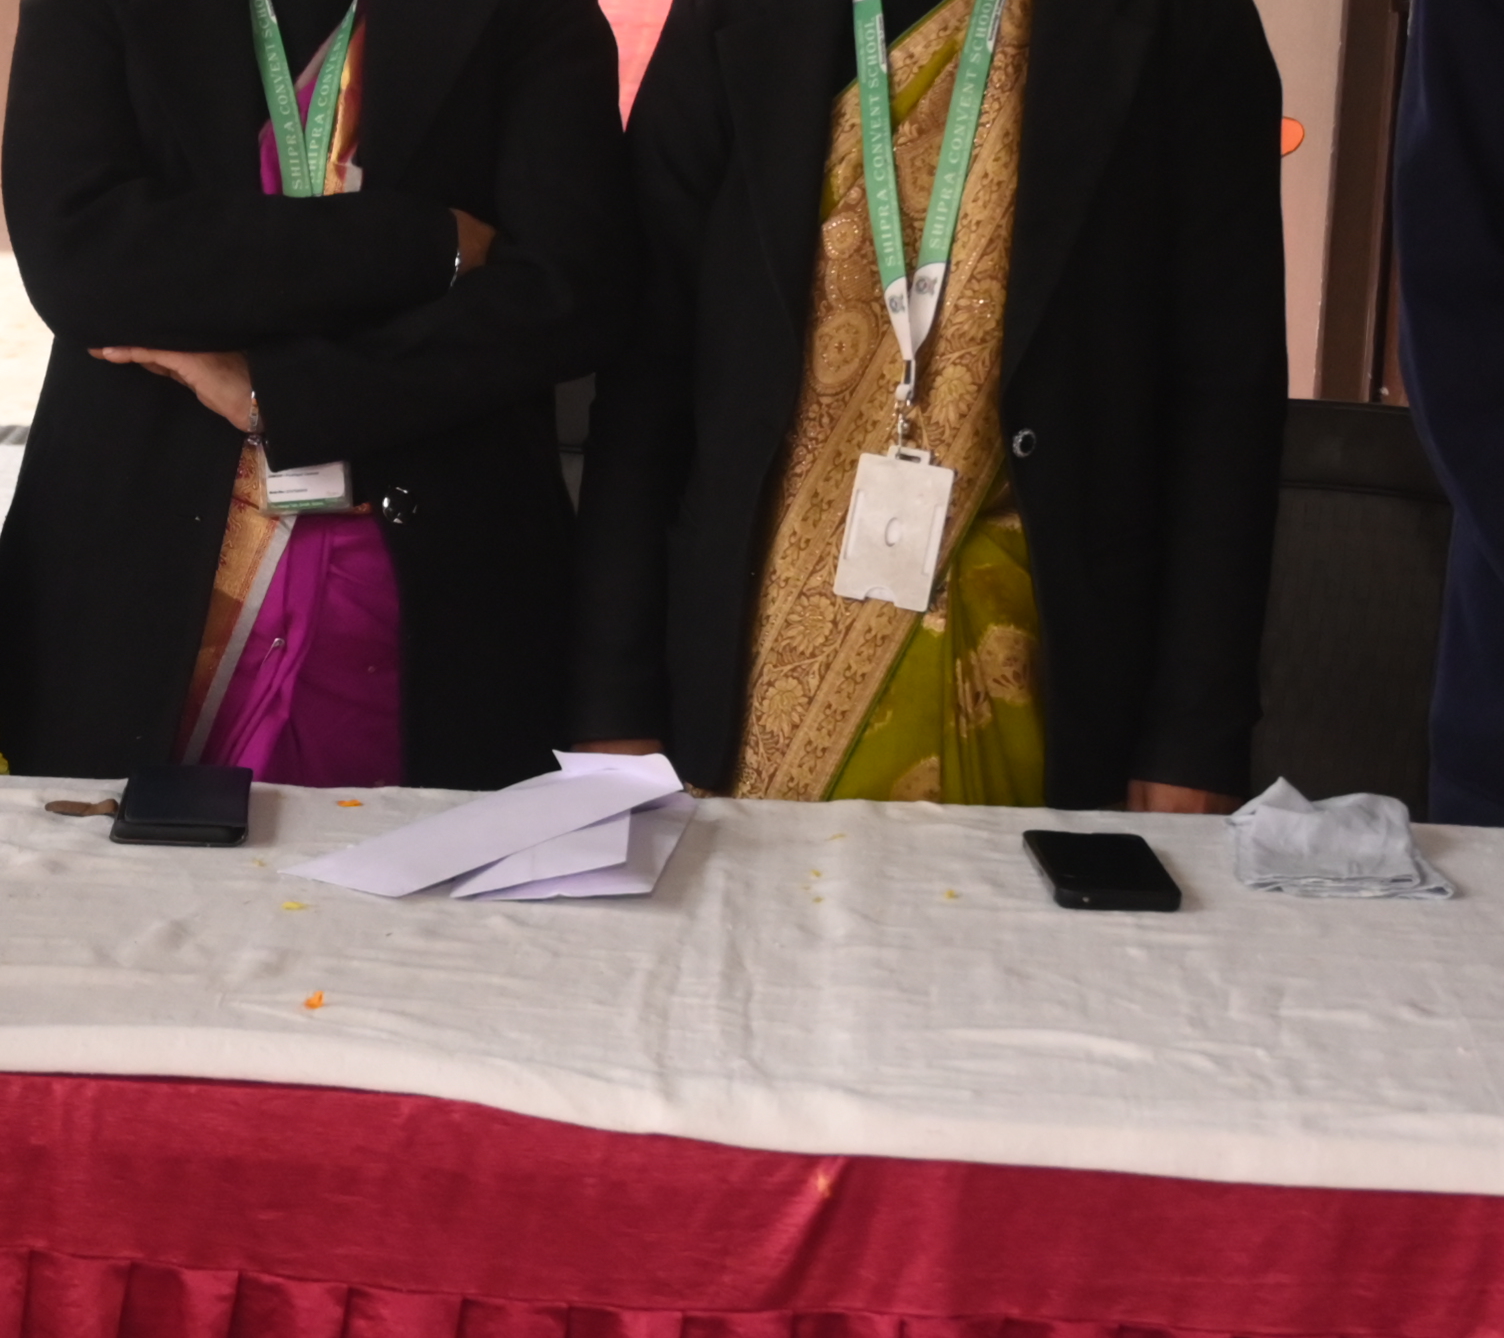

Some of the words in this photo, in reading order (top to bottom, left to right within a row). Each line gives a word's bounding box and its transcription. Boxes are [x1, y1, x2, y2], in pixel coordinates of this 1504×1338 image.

[265, 45, 291, 115] CONVENT
[863, 17, 880, 89] SCHOOL
[284, 122, 303, 190] SHIPRA
[868, 95, 887, 182] CONVENT
[929, 173, 955, 250] SHIPRA
[950, 71, 978, 164] CONVENT
[877, 189, 893, 267] SHIPRA
